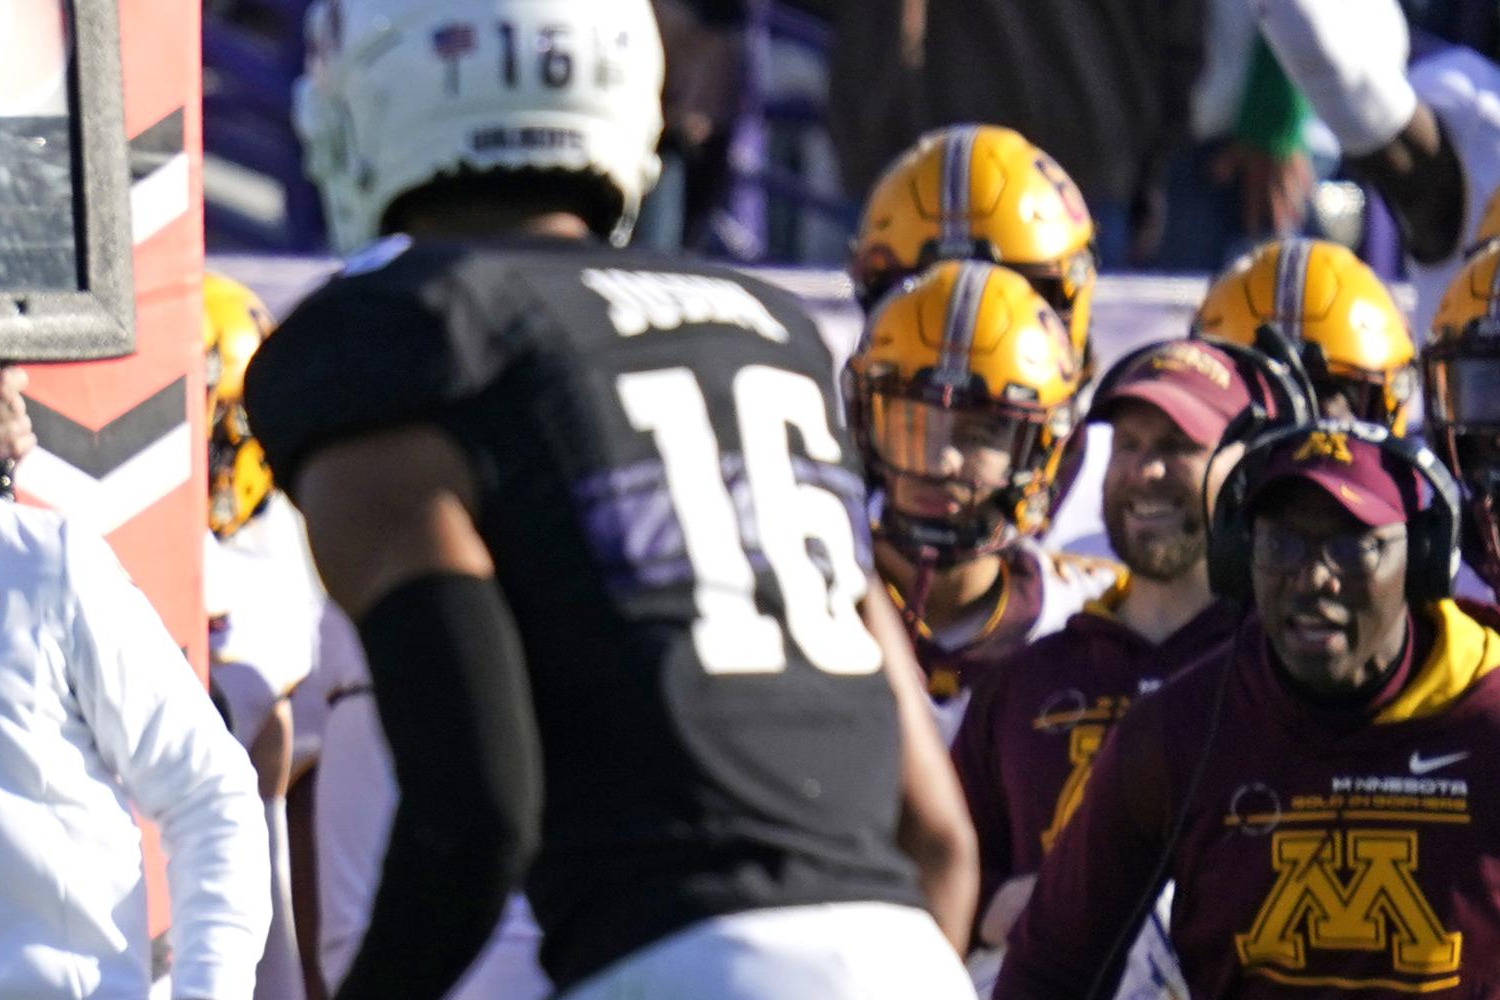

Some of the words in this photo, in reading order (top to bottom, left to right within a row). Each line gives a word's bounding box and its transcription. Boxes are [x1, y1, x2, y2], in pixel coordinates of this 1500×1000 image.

[496, 20, 573, 88] 16
[616, 365, 884, 675] 16
[1331, 776, 1468, 796] MNNESOTA
